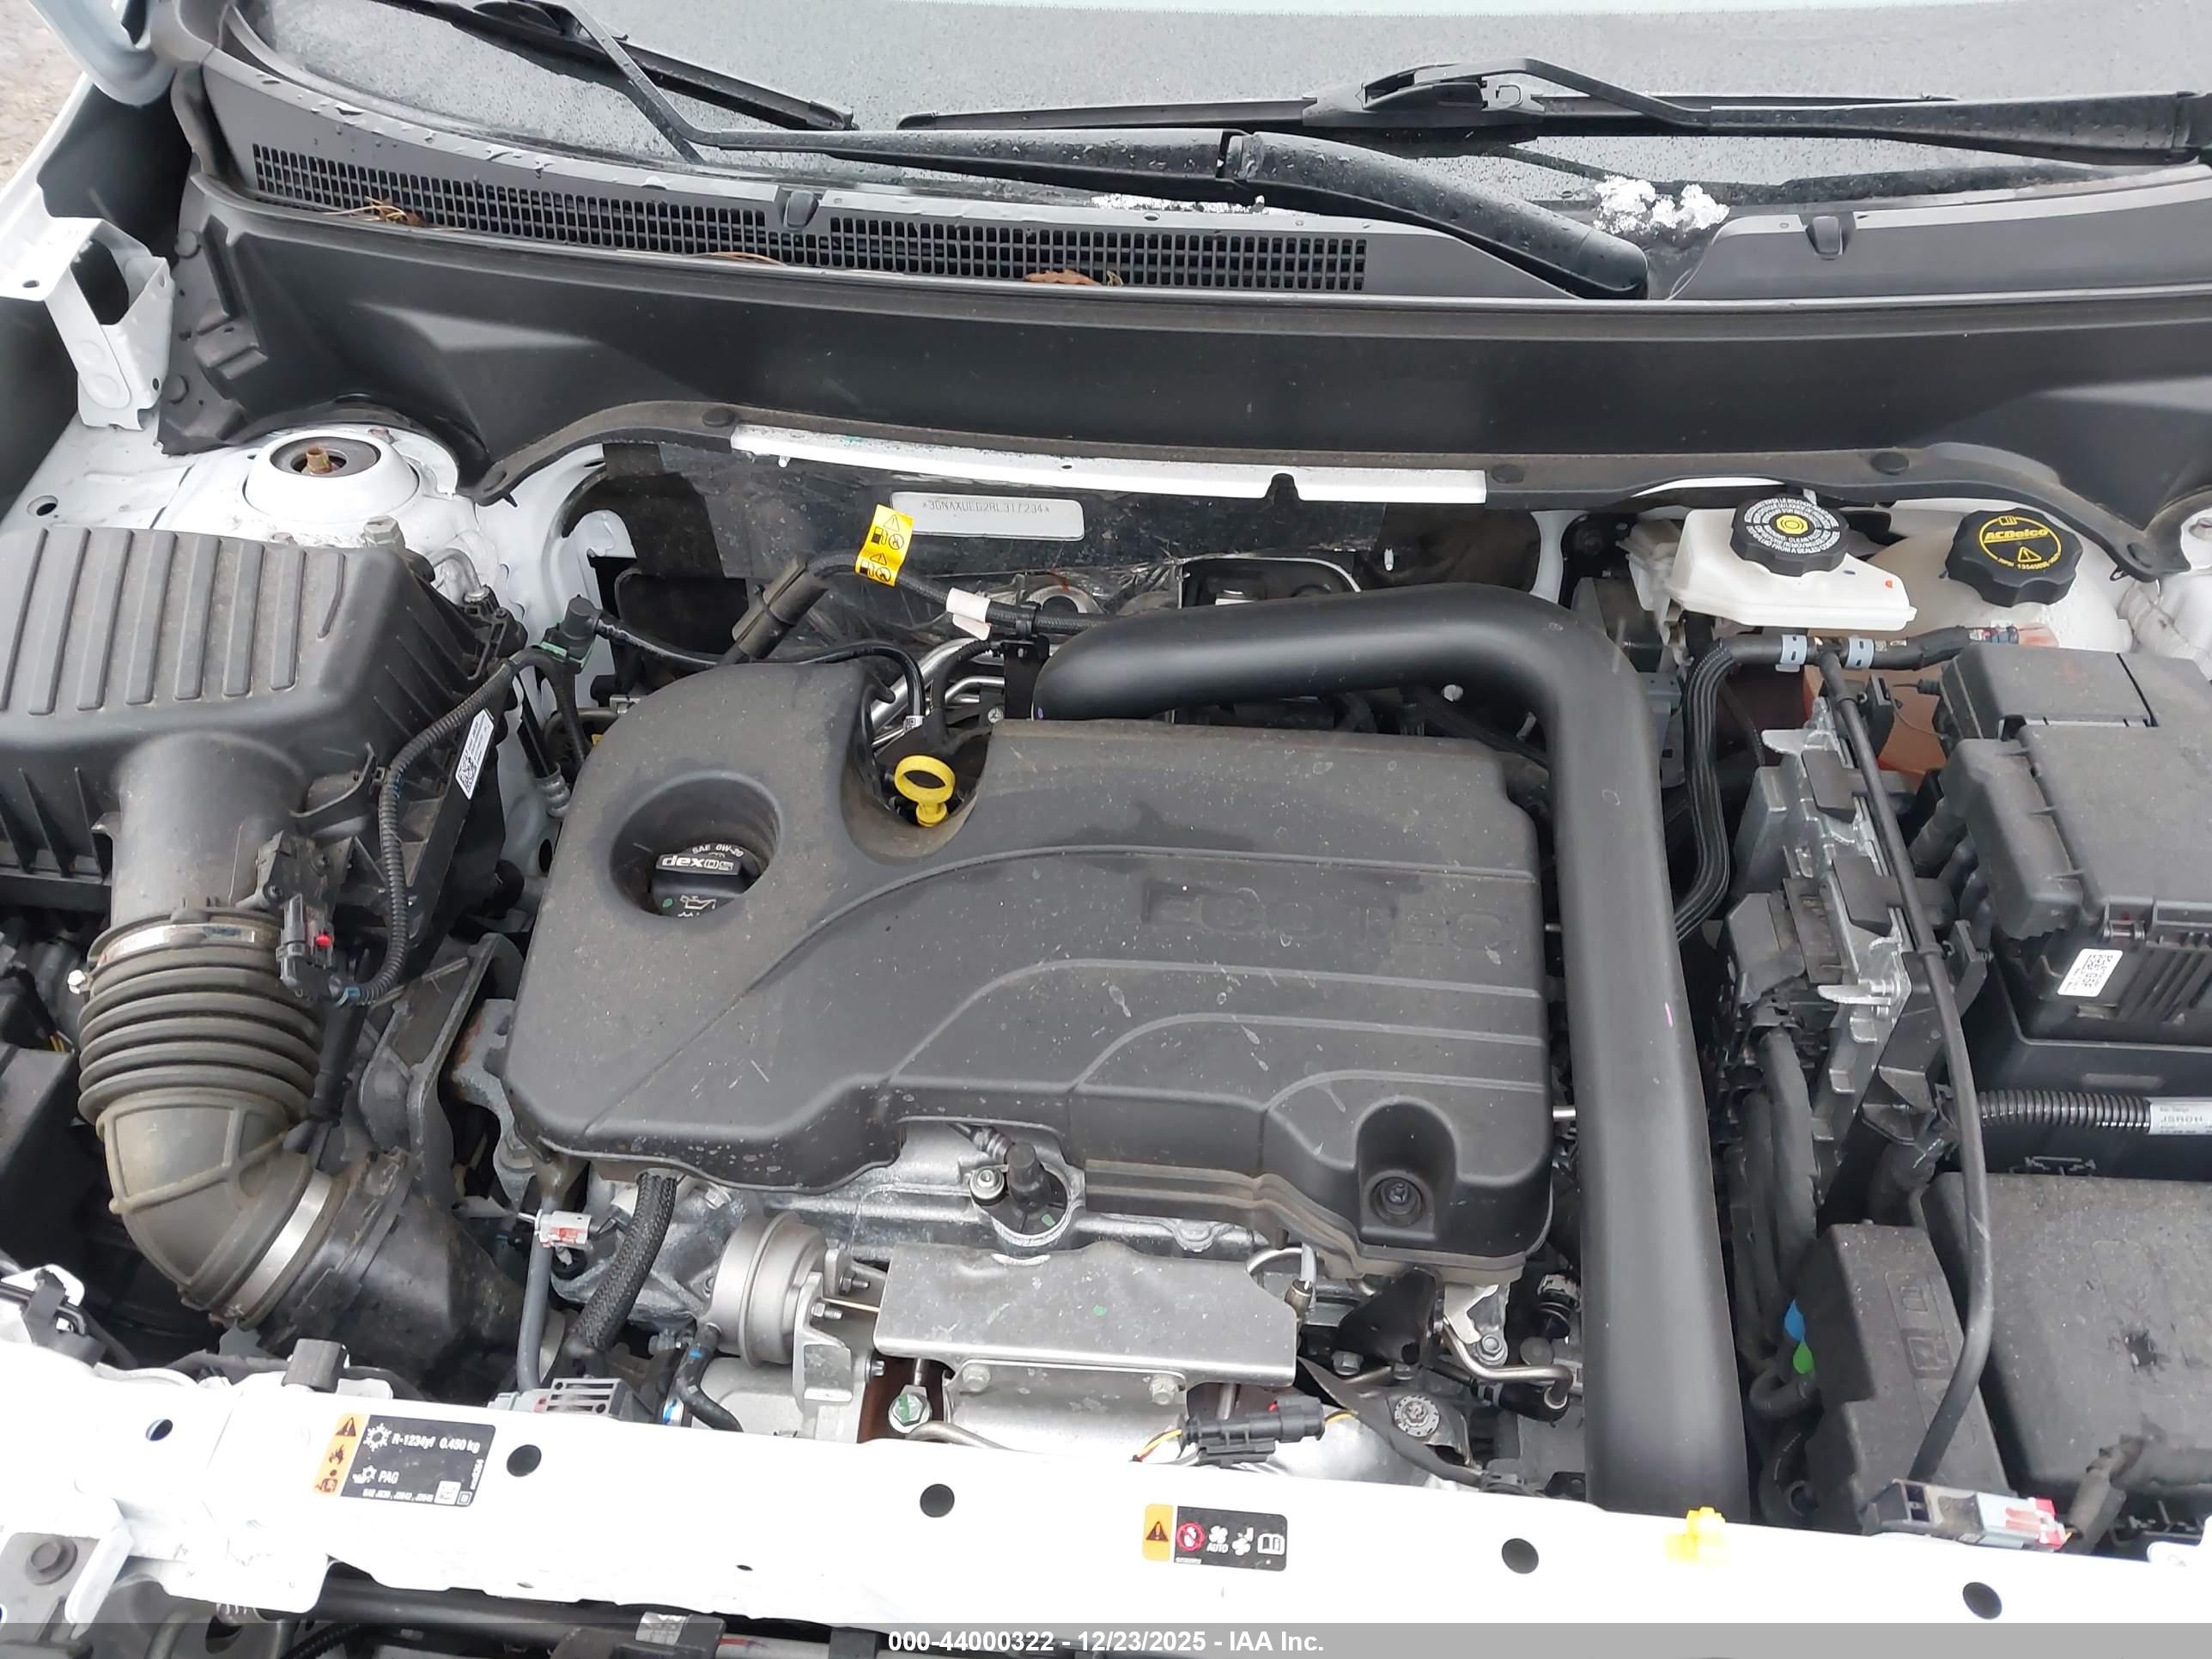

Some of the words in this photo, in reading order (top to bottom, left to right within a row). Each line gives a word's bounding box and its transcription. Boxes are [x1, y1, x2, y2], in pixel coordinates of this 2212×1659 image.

[1984, 529, 2049, 540] ACDelco
[692, 844, 712, 854] SAE
[715, 843, 744, 858] 0W-20
[662, 855, 735, 872] dexos
[392, 1432, 436, 1449] R-1234yf
[439, 1437, 466, 1450] 0.450
[466, 1439, 481, 1454] kg
[378, 1470, 399, 1484] PAG
[1206, 1543, 1229, 1553] AUTO
